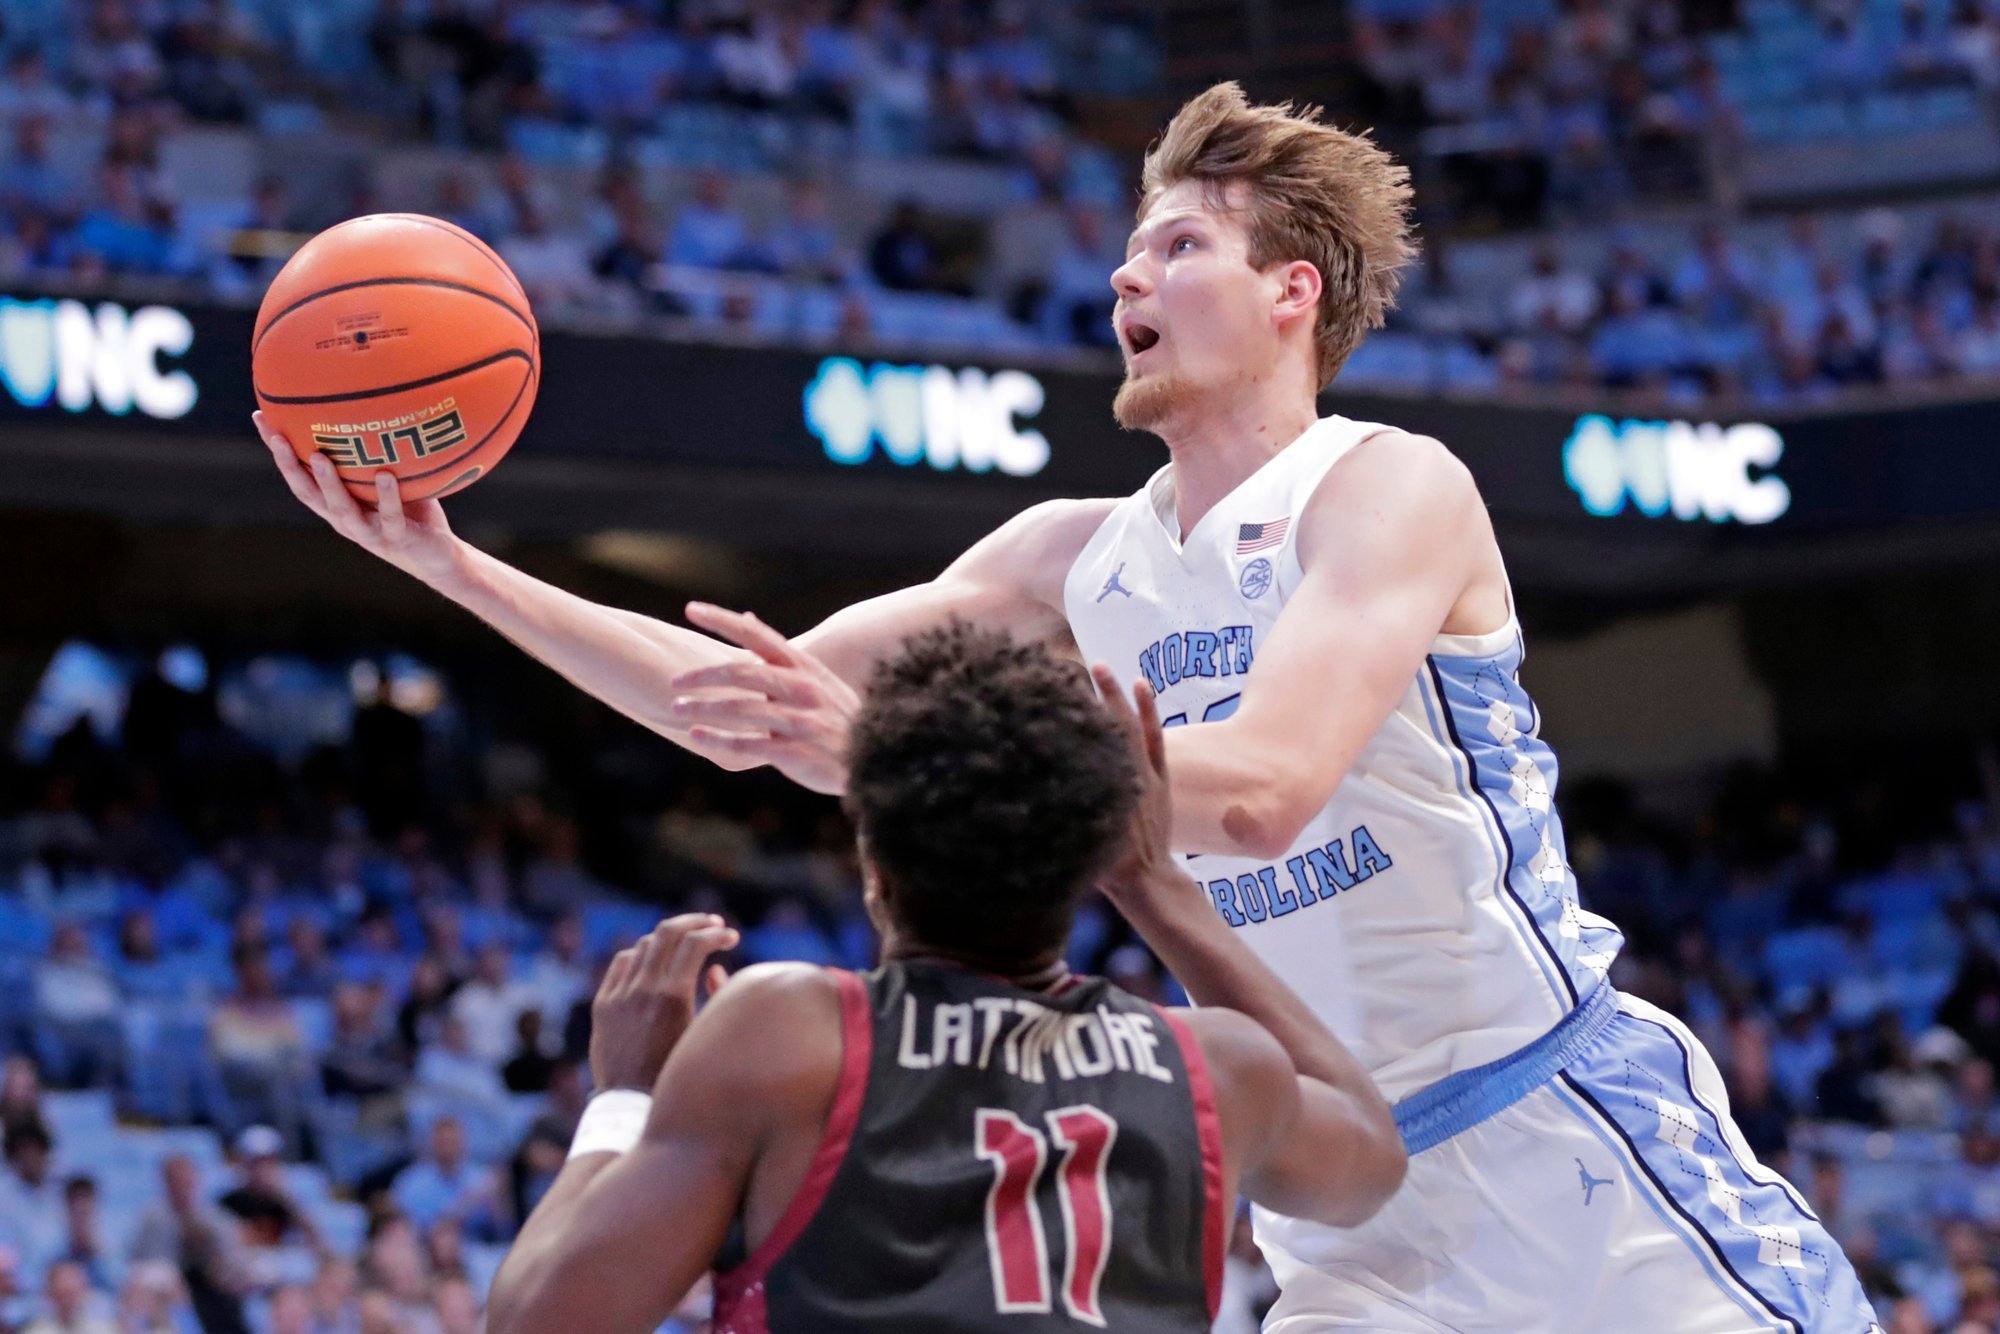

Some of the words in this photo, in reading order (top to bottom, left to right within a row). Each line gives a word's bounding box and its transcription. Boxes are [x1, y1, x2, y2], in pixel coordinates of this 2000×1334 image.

[311, 396, 456, 432] CHAMPIONSHIP
[312, 409, 467, 468] ELITE
[1138, 625, 1254, 698] NORTH
[1196, 825, 1393, 928] ROLINA
[898, 993, 1174, 1084] LATTIMORE
[974, 1103, 1118, 1328] 11
